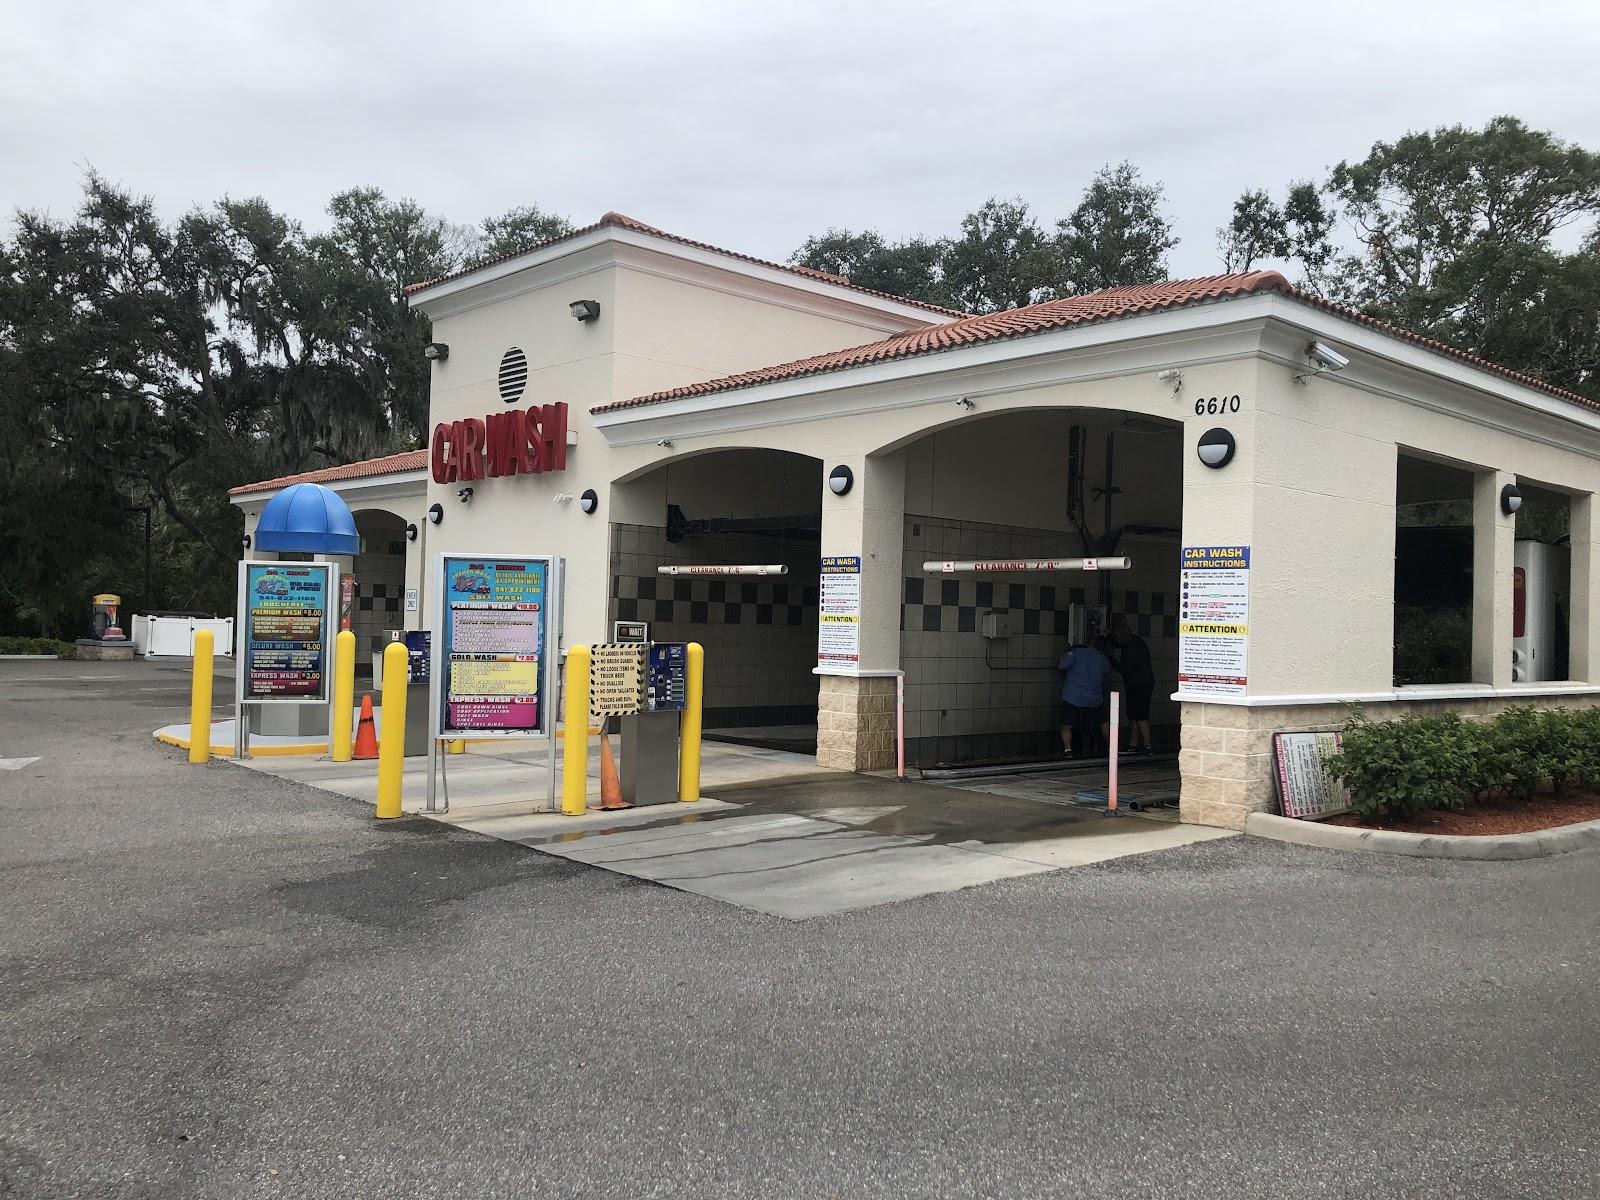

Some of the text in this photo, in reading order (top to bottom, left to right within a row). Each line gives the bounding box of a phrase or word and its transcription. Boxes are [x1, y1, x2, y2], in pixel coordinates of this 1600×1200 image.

[1195, 395, 1240, 415] 6610
[432, 402, 568, 484] CAR WASH
[1185, 549, 1242, 558] CAR WASH
[975, 563, 1028, 572] CLEARANCE
[1184, 560, 1246, 568] INSTRUCTIONS
[629, 628, 642, 636] WAIT
[1189, 625, 1238, 633] ATTENTION
[1276, 736, 1287, 781] INSTRUCTIONS
[1282, 782, 1290, 801] WASH
